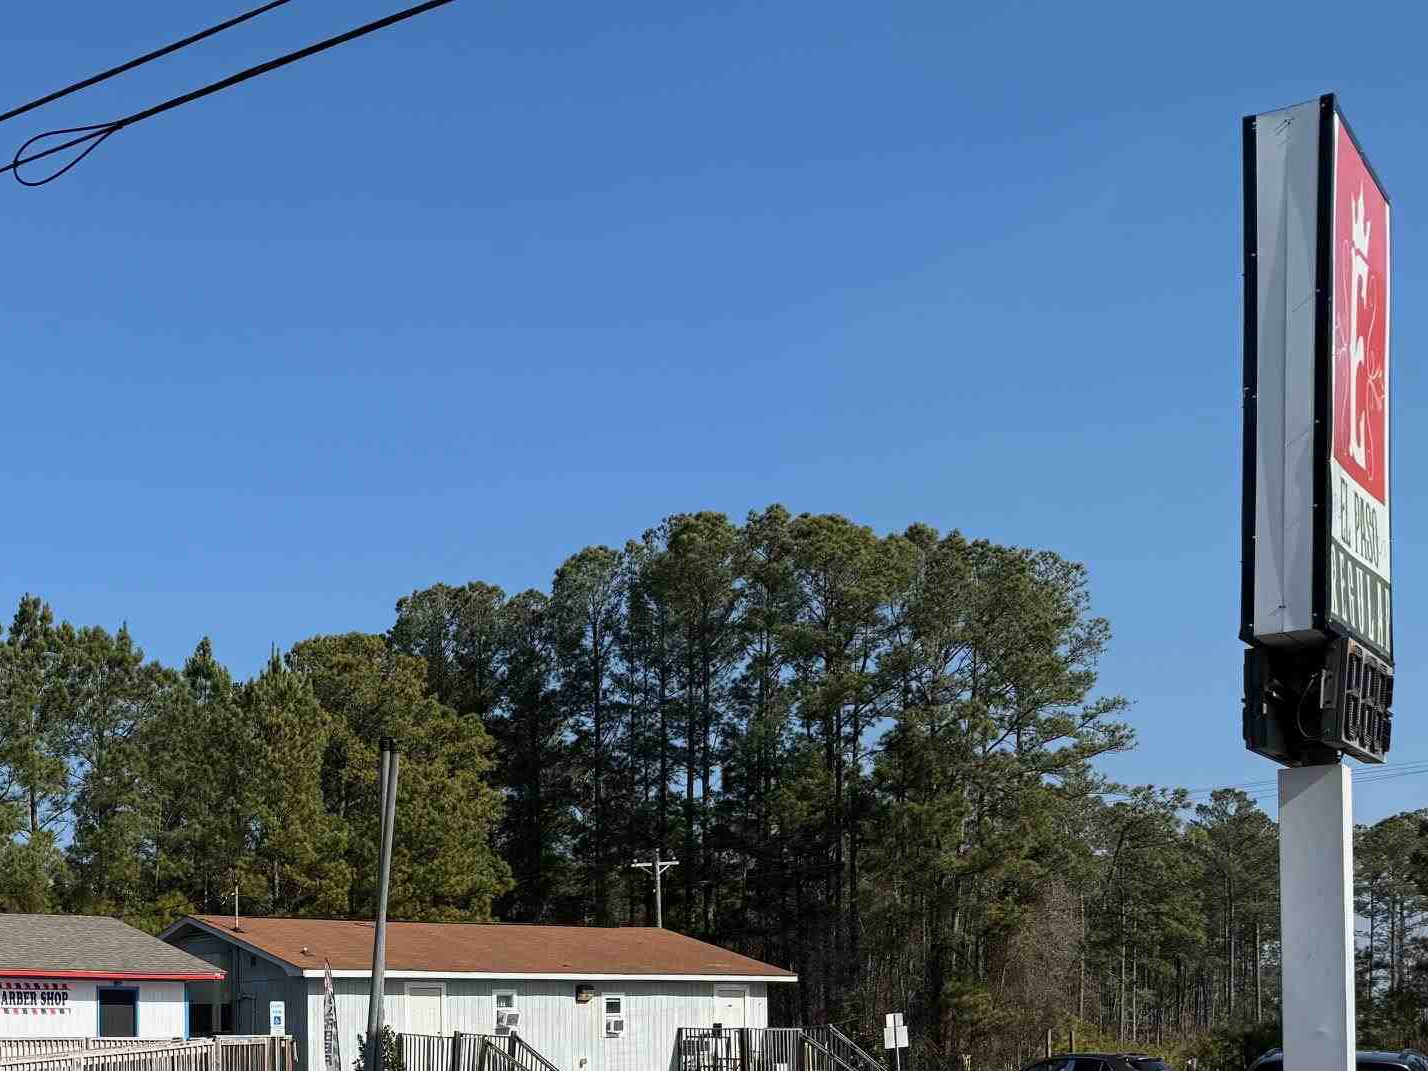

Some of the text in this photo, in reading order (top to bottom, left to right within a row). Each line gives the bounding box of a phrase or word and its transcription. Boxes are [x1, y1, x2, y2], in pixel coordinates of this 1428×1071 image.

[1340, 476, 1379, 569] EL PASO
[40, 991, 68, 1006] SHOP
